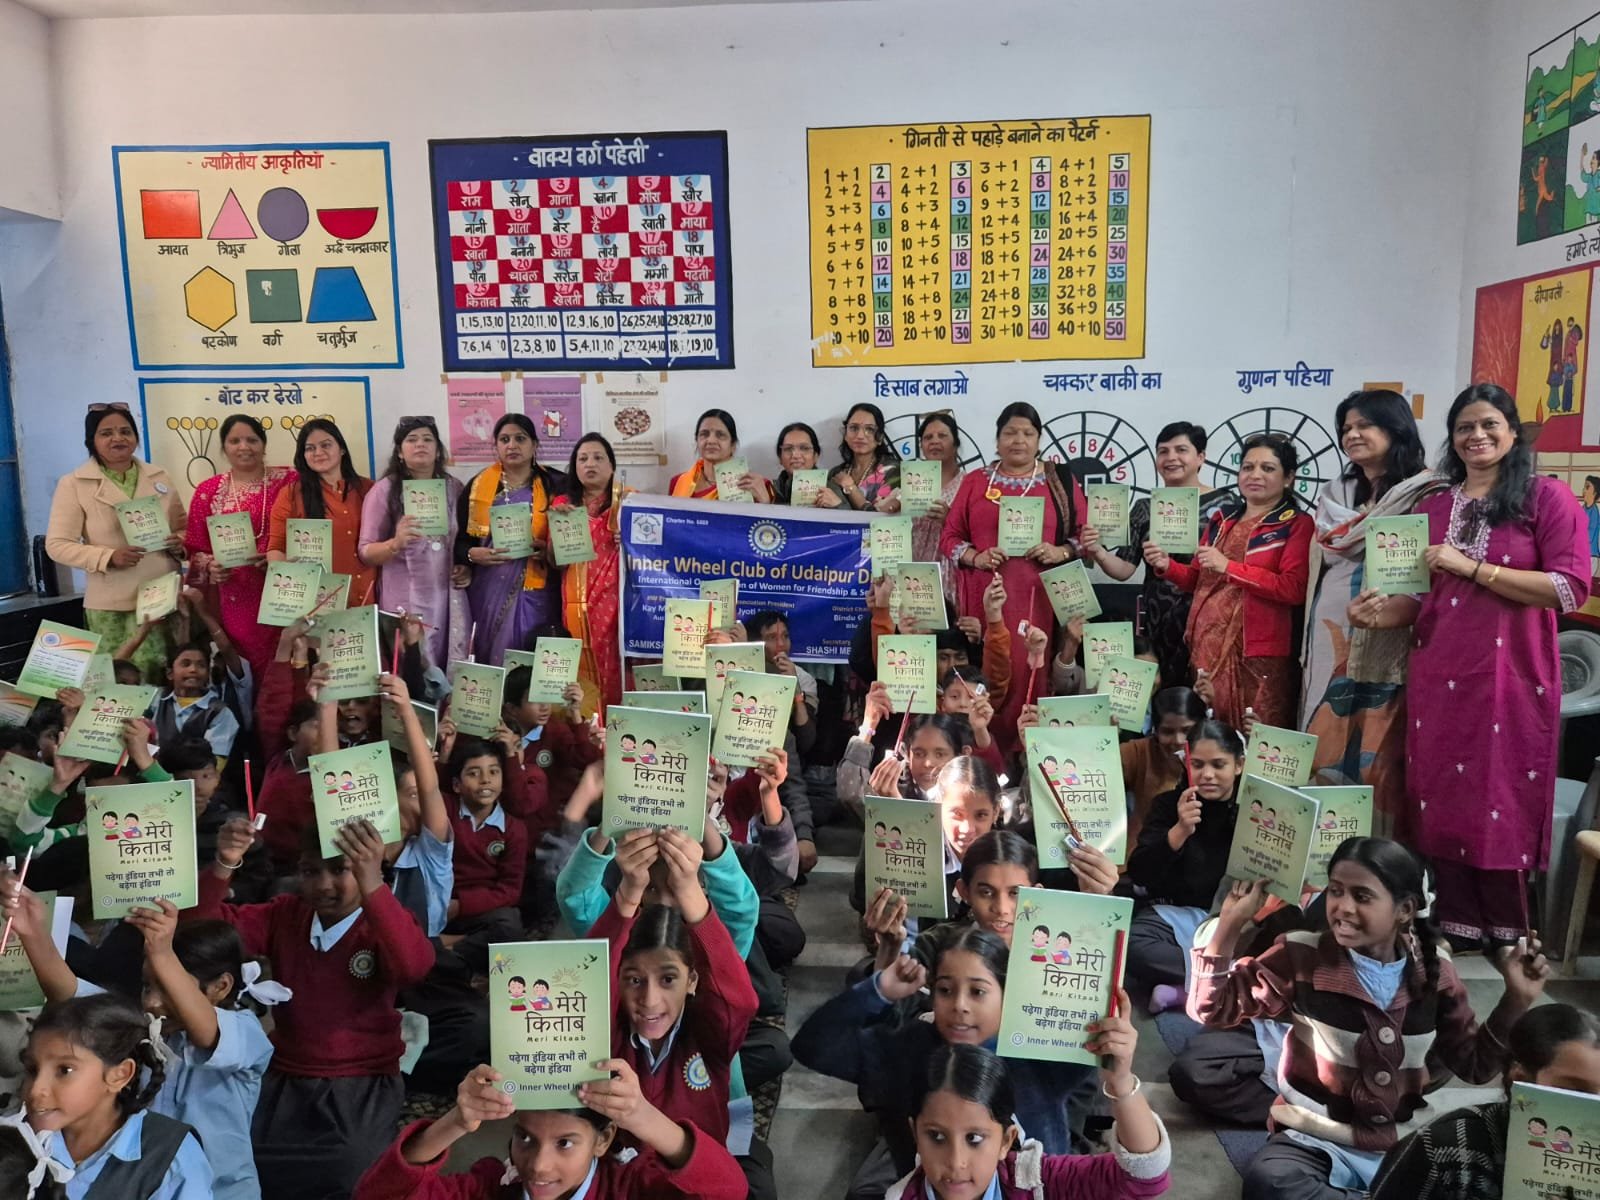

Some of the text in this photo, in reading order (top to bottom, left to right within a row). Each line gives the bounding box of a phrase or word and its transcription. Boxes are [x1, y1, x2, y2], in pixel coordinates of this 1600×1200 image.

[952, 124, 968, 148] से
[1008, 122, 1045, 144] बनाने
[1047, 128, 1065, 142] का
[528, 137, 649, 168] वाक्य वर्ग पहेली
[201, 152, 258, 170] ज्यामितीय
[1036, 158, 1047, 171] 4
[1113, 157, 1124, 169] 5
[876, 166, 885, 179] 2
[957, 162, 967, 176] 3
[510, 181, 518, 193] 2
[556, 179, 565, 190] 3
[598, 177, 608, 188] 4
[644, 177, 652, 188] 5
[684, 176, 693, 188] 6
[461, 195, 482, 207] राम
[1034, 194, 1046, 207] 12
[1112, 192, 1125, 204] 15
[878, 205, 886, 217] 6
[957, 201, 966, 212] 9
[1034, 230, 1047, 240] 20
[1110, 227, 1125, 239] 25
[877, 241, 888, 252] 10
[957, 235, 969, 247] 15
[158, 244, 188, 255] आयत
[216, 240, 247, 259] त्रिभुज
[955, 273, 967, 285] 21
[1108, 266, 1124, 279] 35
[955, 309, 968, 320] 27
[1031, 304, 1047, 316] 36
[1107, 303, 1124, 316] 45
[878, 315, 889, 325] 18
[262, 329, 284, 346] वर्ग
[873, 370, 969, 397] हिसाब लगाओ
[1100, 365, 1138, 391] बाकी
[1142, 372, 1162, 390] का
[1236, 361, 1334, 394] गुणन पहिया
[247, 389, 270, 404] कर
[273, 383, 303, 405] देखो
[902, 442, 914, 456] 6
[1068, 440, 1076, 453] 6
[1088, 439, 1096, 452] 8
[1104, 448, 1115, 461] 4
[1116, 467, 1126, 481] 5
[1302, 464, 1310, 475] 6
[1299, 481, 1307, 492] 8
[628, 554, 670, 572] Inner
[674, 556, 726, 575] Wheel
[730, 561, 766, 578] Club
[770, 563, 788, 579] of
[792, 565, 855, 586] Udaipur
[638, 576, 692, 586] International
[748, 582, 758, 590] of
[759, 583, 791, 591] Women
[793, 584, 805, 592] for
[807, 585, 848, 597] Friendship
[806, 646, 838, 654] SHASHI
[909, 655, 925, 668] मेरी
[894, 665, 925, 677] किताब
[759, 705, 778, 719] मेरी
[738, 714, 775, 729] किताब
[661, 751, 689, 771] मेरी
[1282, 755, 1300, 769] मेरी
[633, 764, 687, 786] किताब
[1263, 761, 1297, 778] किताब
[356, 773, 379, 788] मेरी
[1082, 769, 1107, 787] मेरी
[338, 788, 379, 806] किताब
[1060, 786, 1107, 804] किताब
[144, 820, 174, 839] मेरी
[1339, 817, 1360, 830] मेरी
[1278, 821, 1296, 840] मेरी
[1256, 825, 1294, 851] किताब
[118, 839, 172, 857] किताब
[905, 837, 927, 856] मेरी
[885, 849, 926, 869] किताब
[1076, 947, 1107, 972] मेरी
[1043, 964, 1102, 992] किताब
[555, 991, 587, 1013] मेरी
[525, 1011, 586, 1033] किताब
[1028, 1037, 1077, 1048] Inner Wheel
[559, 1050, 575, 1061] तभी
